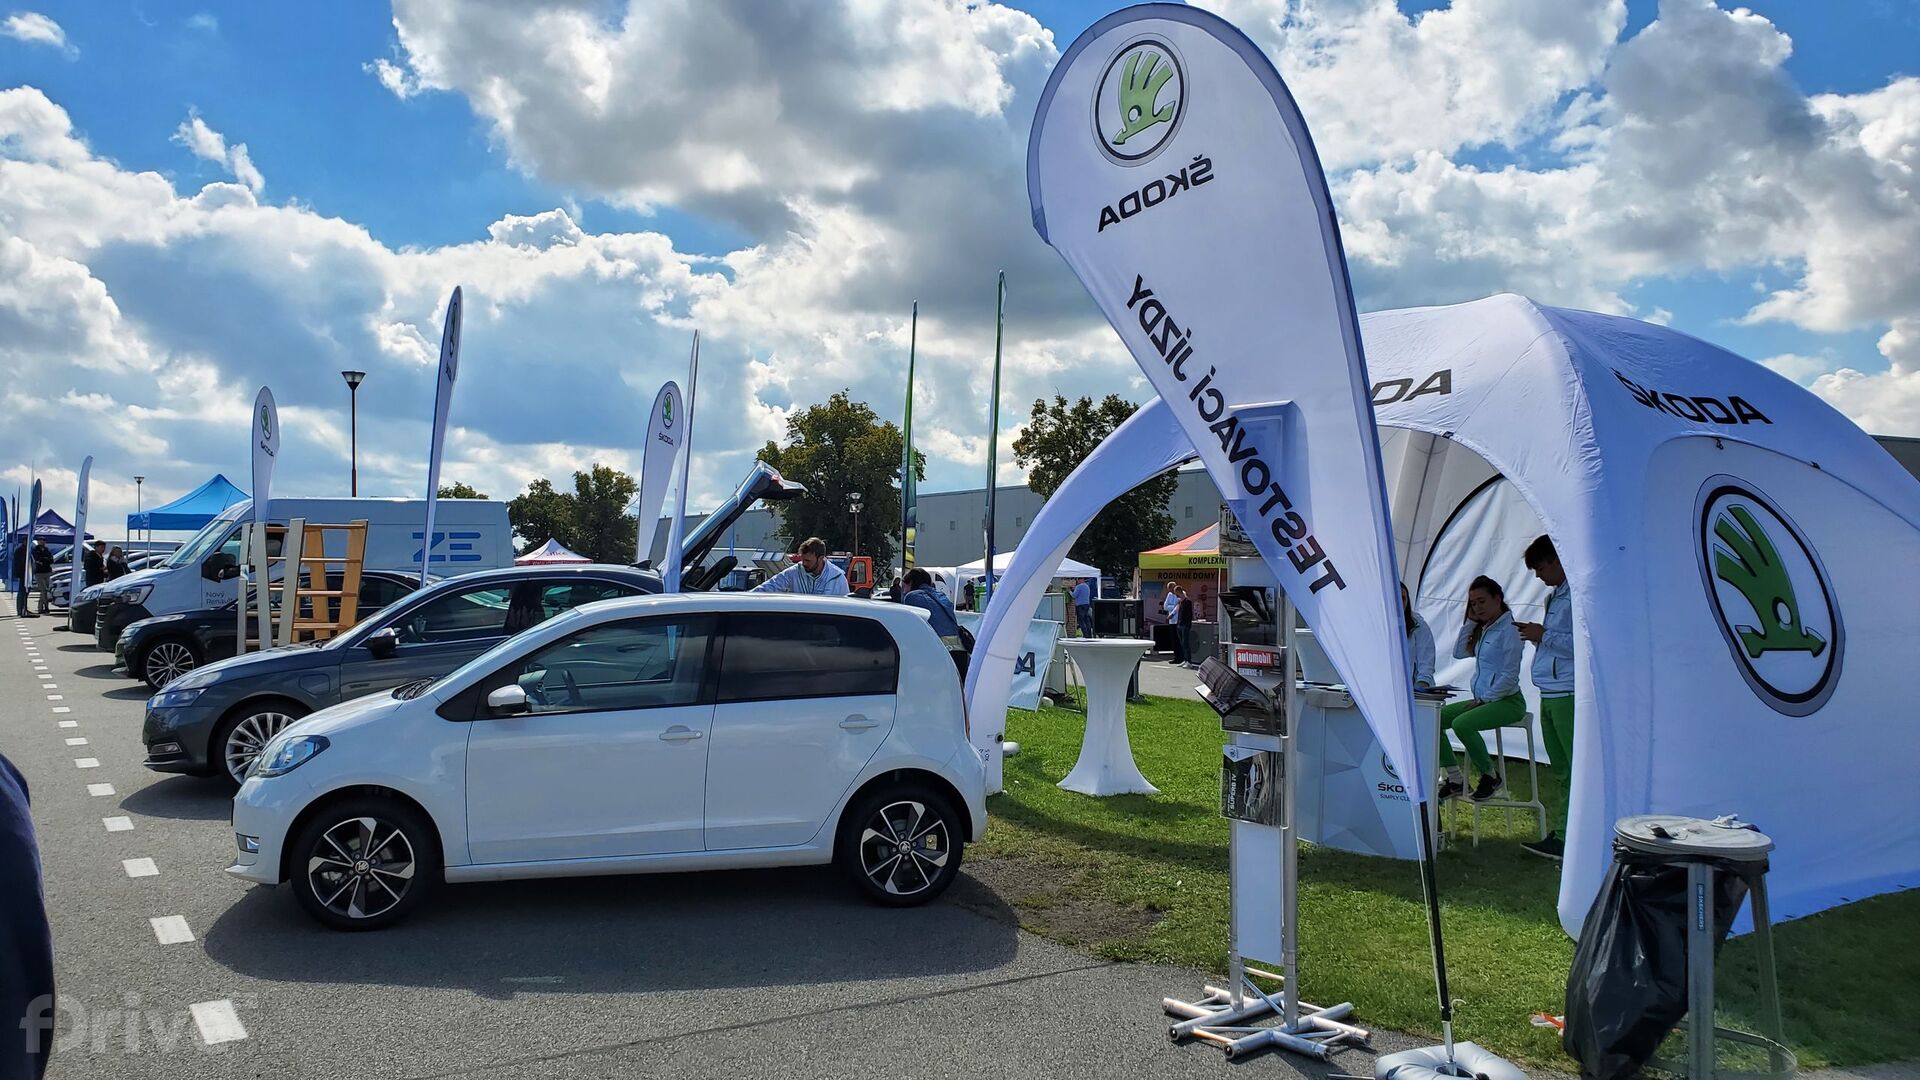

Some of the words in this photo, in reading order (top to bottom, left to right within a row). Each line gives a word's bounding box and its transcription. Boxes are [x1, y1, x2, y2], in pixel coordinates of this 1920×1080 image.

[1370, 368, 1452, 407] DA
[1610, 367, 1774, 425] ŠKODA
[1193, 571, 1216, 580] DOMY
[1237, 651, 1272, 665] automobil
[1377, 782, 1410, 793] ŠKO
